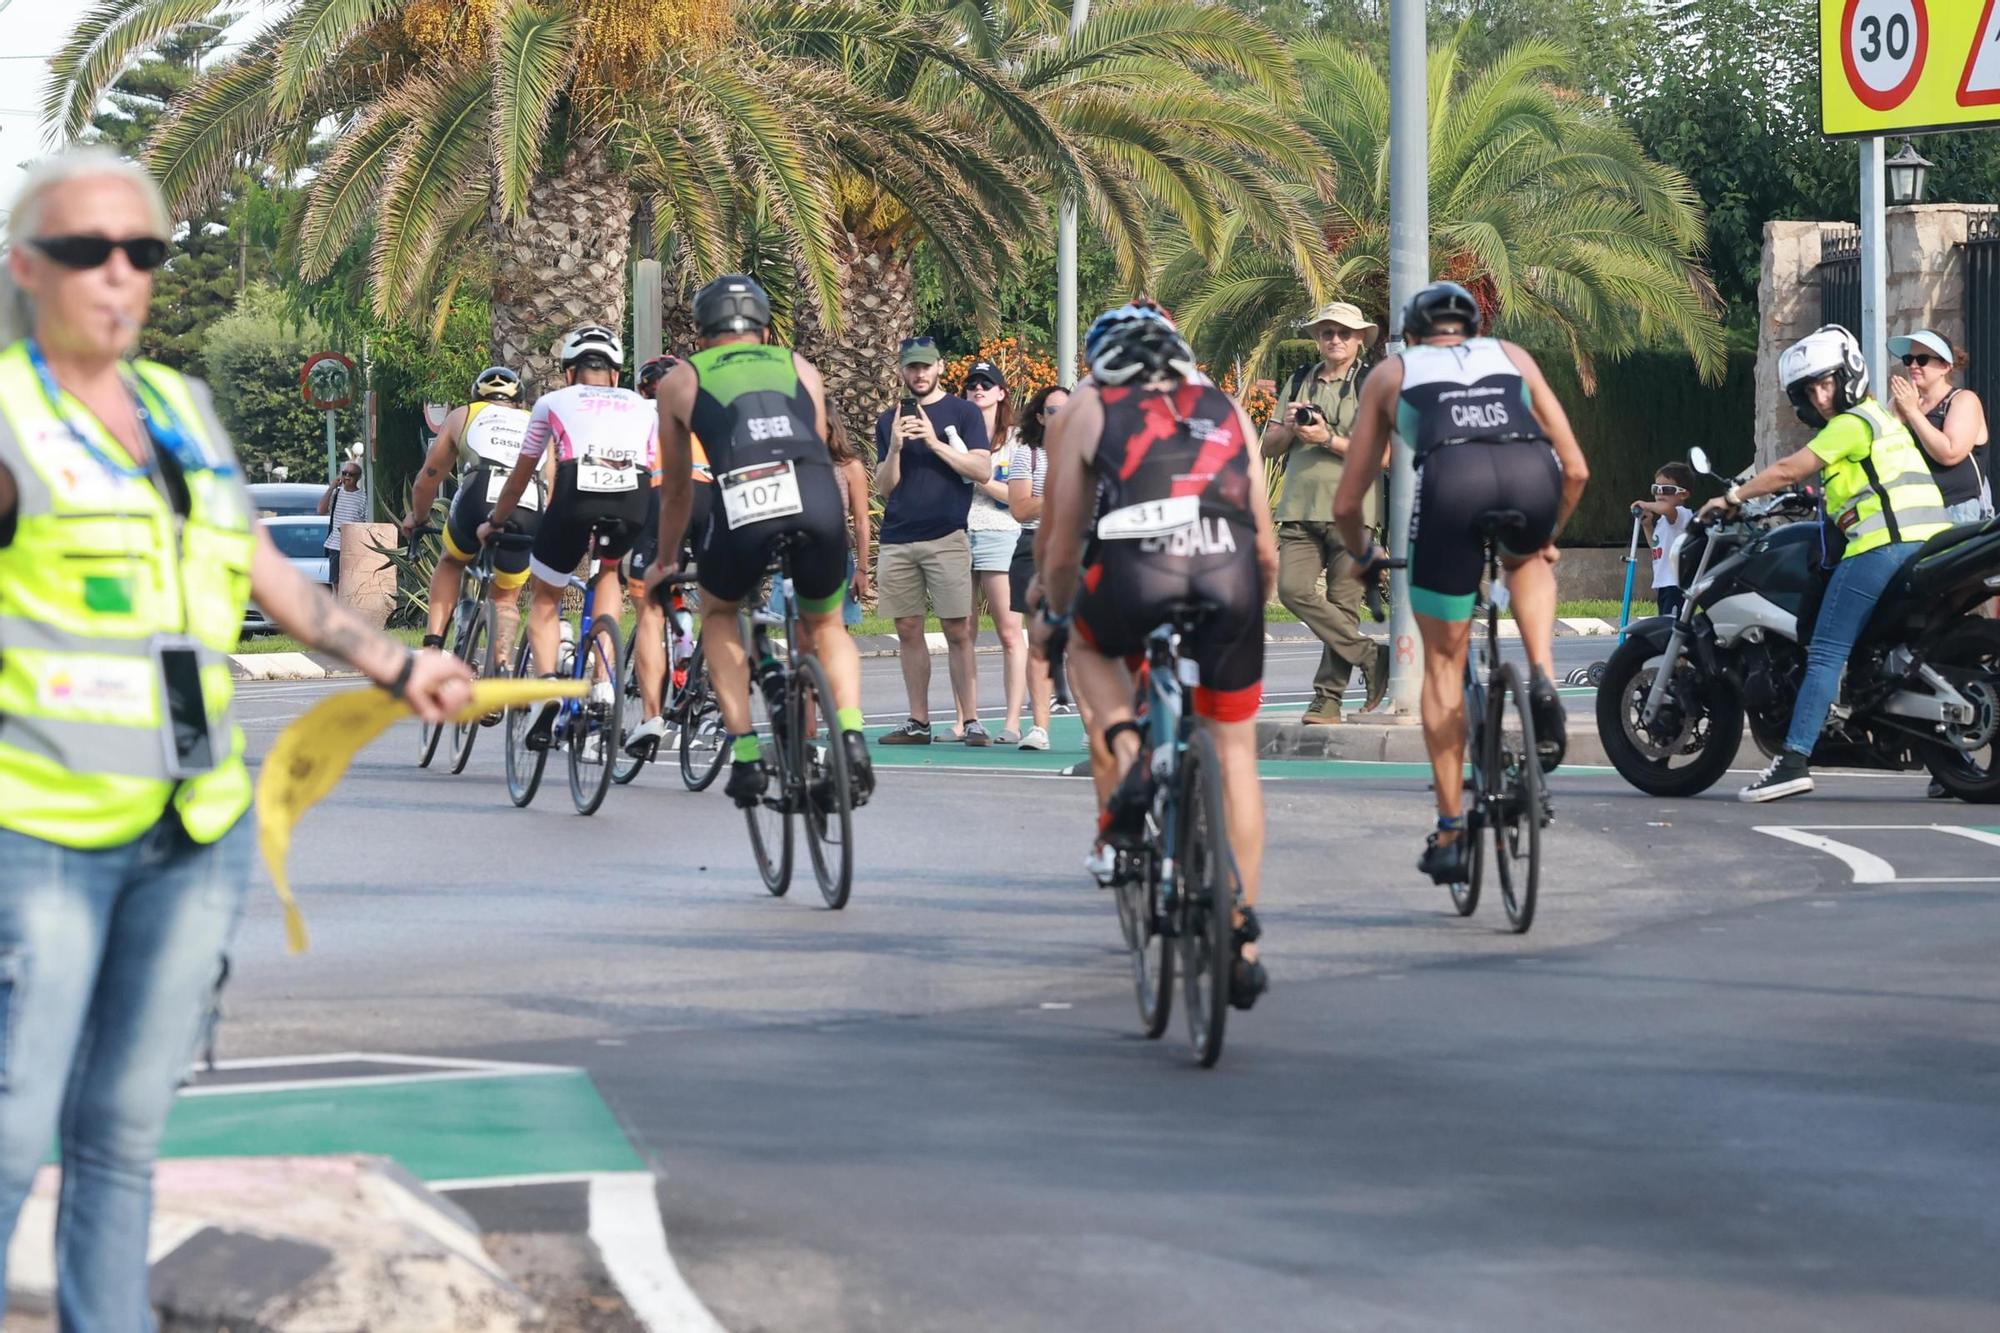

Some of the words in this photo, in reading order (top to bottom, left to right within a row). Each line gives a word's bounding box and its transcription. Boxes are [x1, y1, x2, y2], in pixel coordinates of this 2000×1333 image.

[1860, 13, 1909, 62] 30
[1451, 402, 1509, 427] CARLOS
[590, 471, 626, 486] 124
[738, 482, 781, 509] 107
